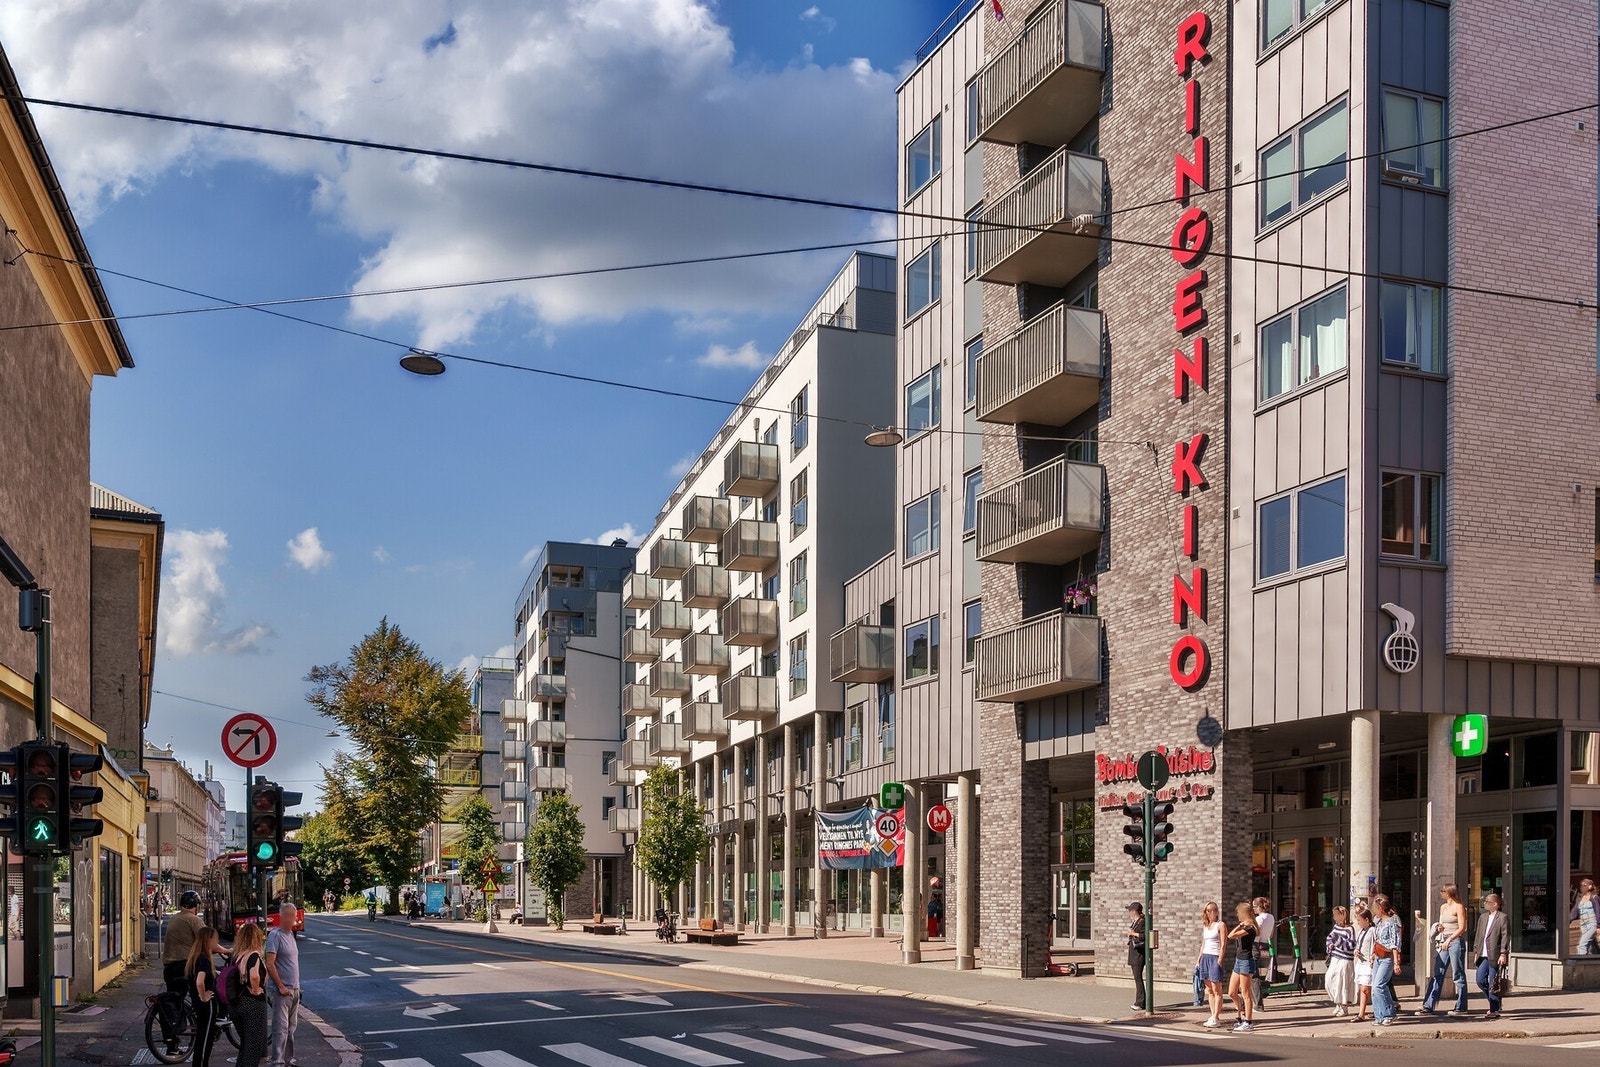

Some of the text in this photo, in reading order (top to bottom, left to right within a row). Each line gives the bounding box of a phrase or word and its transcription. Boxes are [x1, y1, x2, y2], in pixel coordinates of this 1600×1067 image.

[1169, 11, 1211, 689] RINGEN KINO
[1097, 745, 1213, 781] Bomb uisine
[880, 820, 896, 832] 40
[933, 810, 947, 824] M
